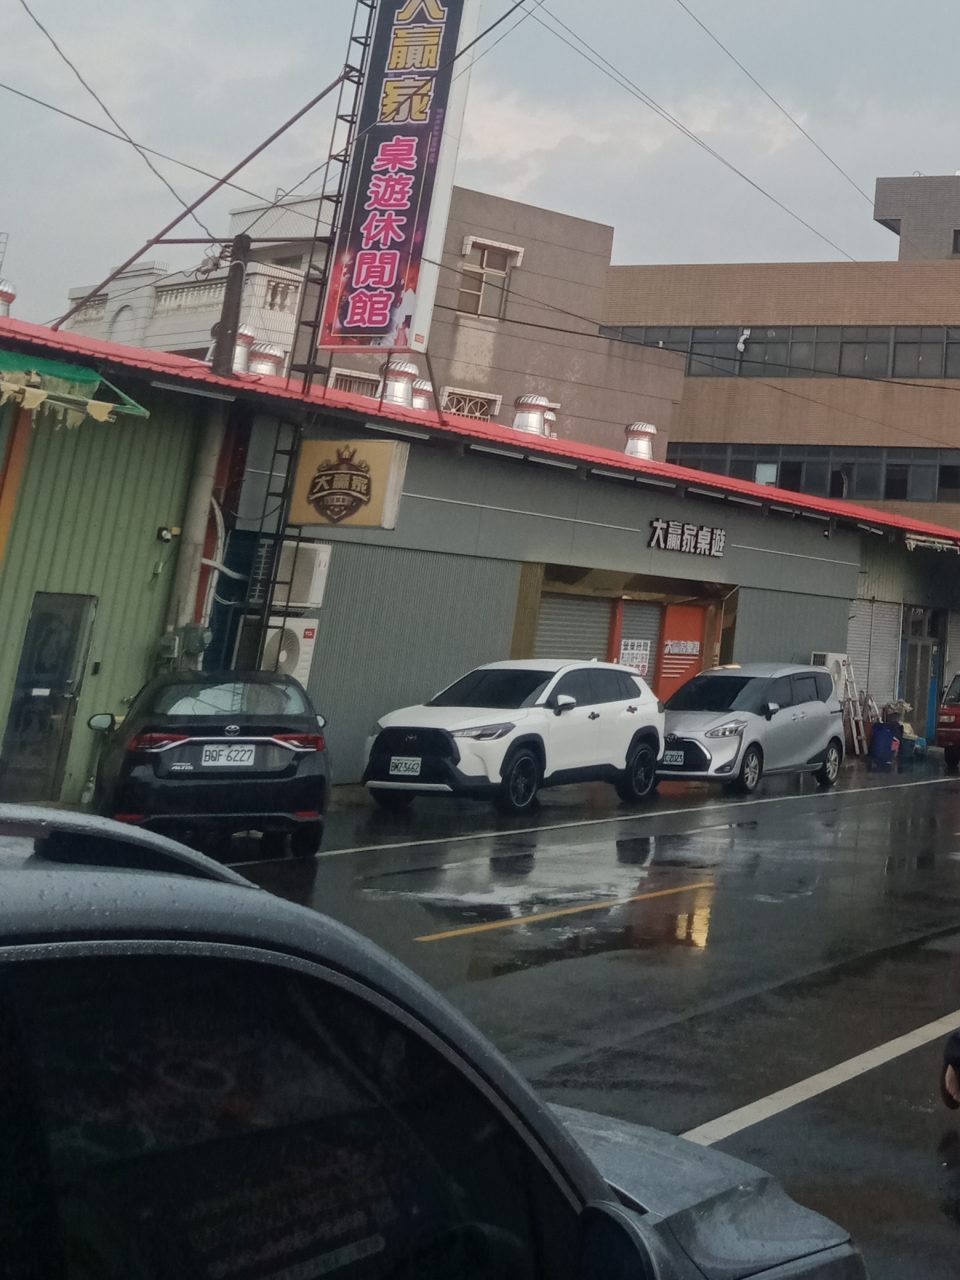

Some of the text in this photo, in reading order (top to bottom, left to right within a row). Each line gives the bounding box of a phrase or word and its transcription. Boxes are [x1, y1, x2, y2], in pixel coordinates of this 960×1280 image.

[344, 135, 418, 328] 桌遊休閒館
[650, 518, 726, 557] 大贏家桌遊
